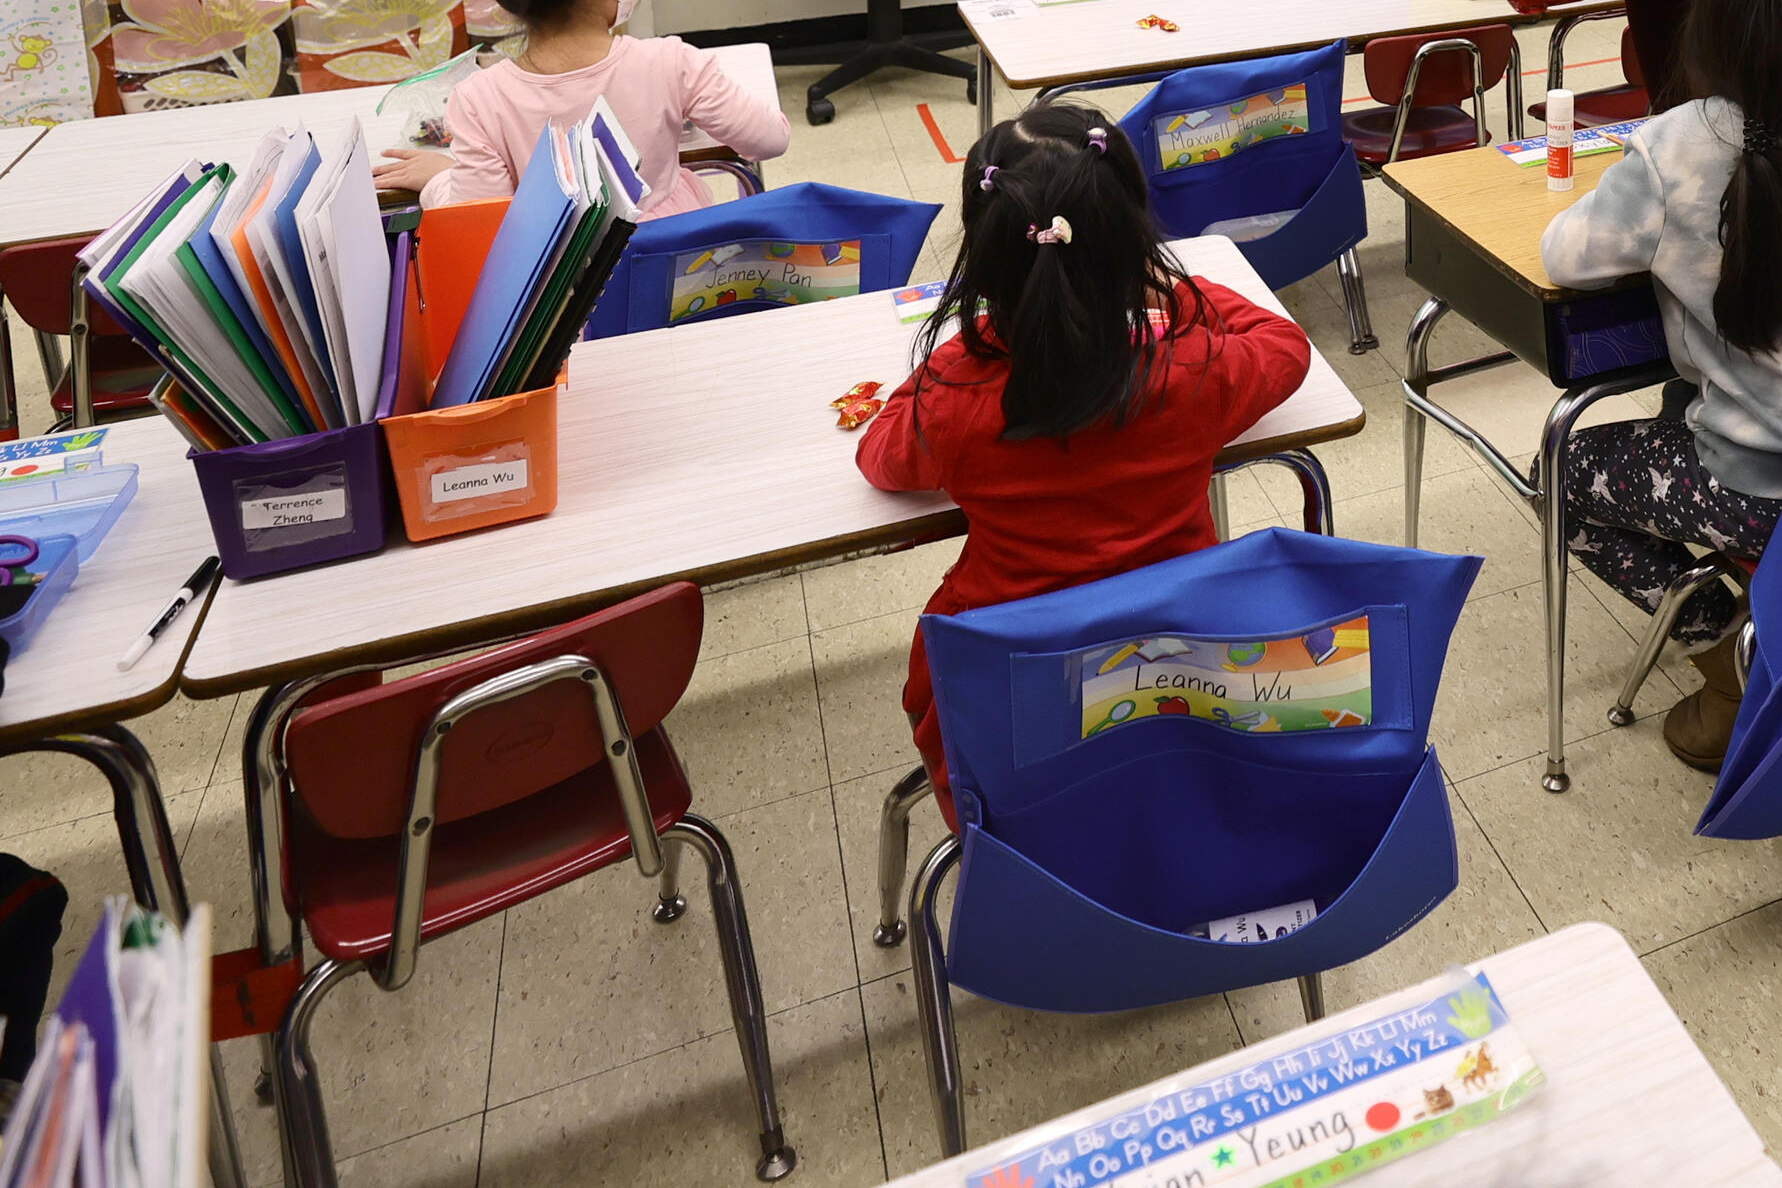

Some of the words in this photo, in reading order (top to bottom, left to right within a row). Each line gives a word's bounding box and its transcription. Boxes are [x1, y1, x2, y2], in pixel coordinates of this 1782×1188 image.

[1170, 122, 1230, 151] Maxwell
[1237, 105, 1296, 133] Hernandez
[706, 264, 771, 289] Jenney
[782, 262, 812, 288] Pan
[443, 477, 488, 493] Leanna
[493, 472, 514, 484] Wu
[263, 496, 323, 512] Terrence
[1134, 665, 1228, 700] Leanna
[1252, 670, 1292, 702] Wu
[1241, 1068, 1273, 1093] Gg
[1327, 1037, 1349, 1063] Jj
[1400, 1010, 1438, 1033] Mm
[1089, 1153, 1121, 1176] Oo
[1123, 1140, 1152, 1166] Pp
[1156, 1128, 1188, 1155] Qq
[1330, 1061, 1370, 1085] Ww
[1235, 1110, 1356, 1165] Yeung
